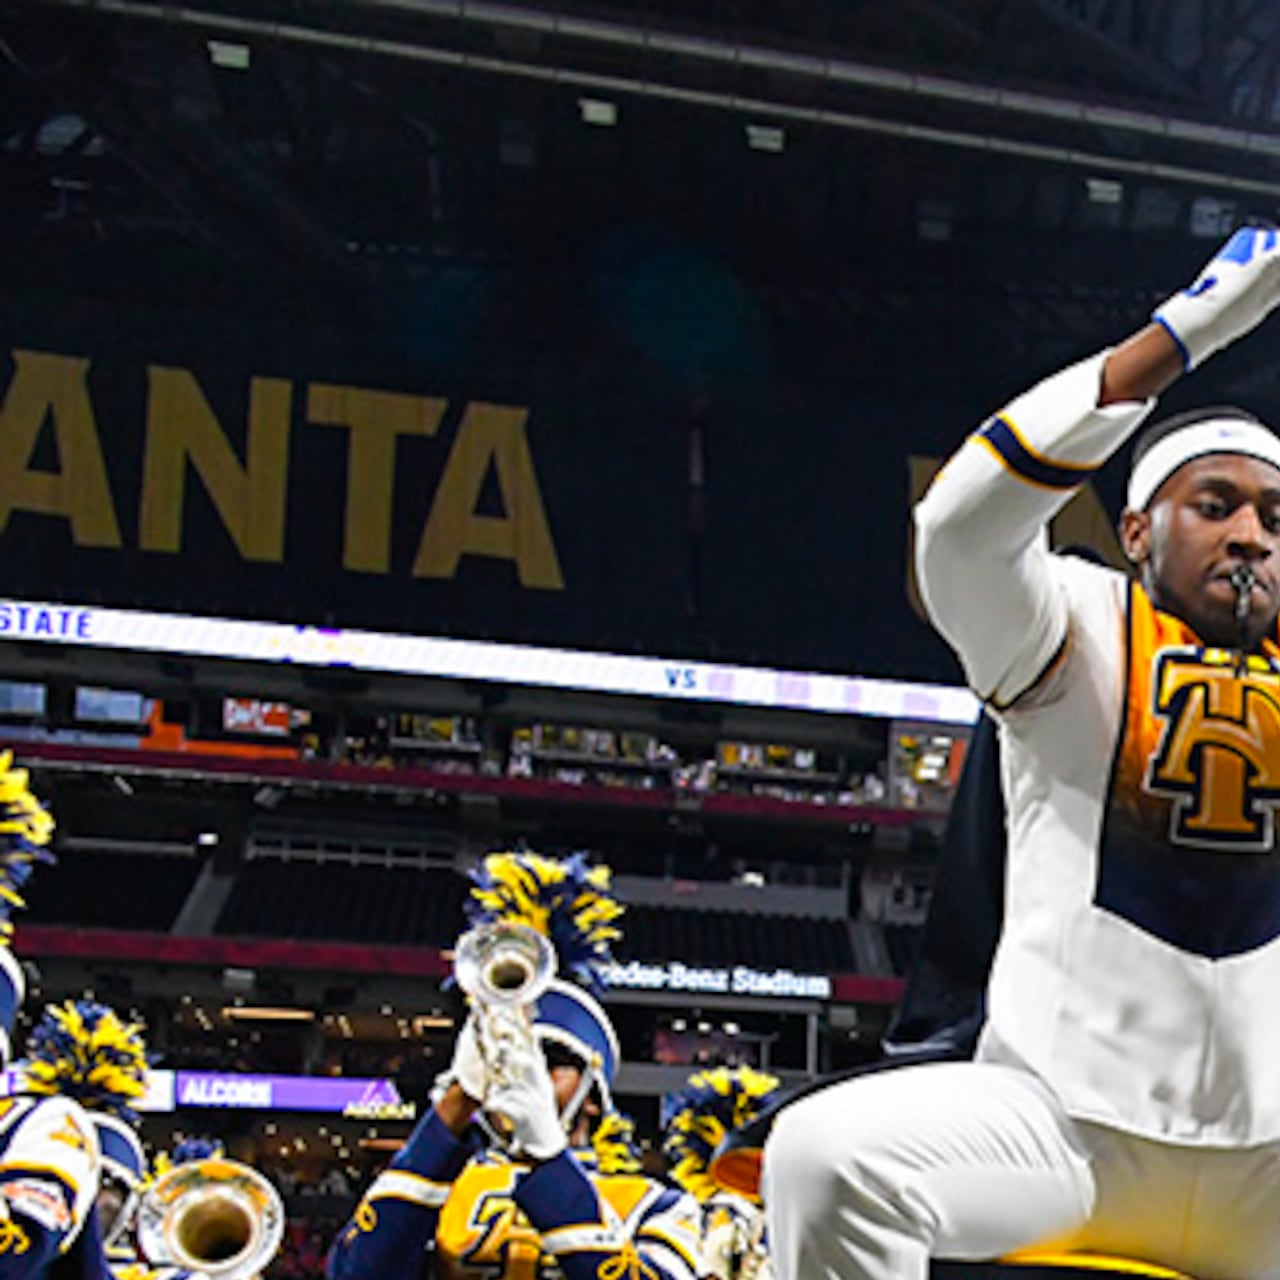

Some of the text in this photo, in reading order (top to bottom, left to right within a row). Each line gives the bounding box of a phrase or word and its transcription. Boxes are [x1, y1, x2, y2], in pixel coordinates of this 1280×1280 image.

[0, 349, 565, 589] ANTA
[664, 667, 697, 689] VS
[733, 966, 830, 996] Stadium
[181, 1078, 272, 1107] ALCORN
